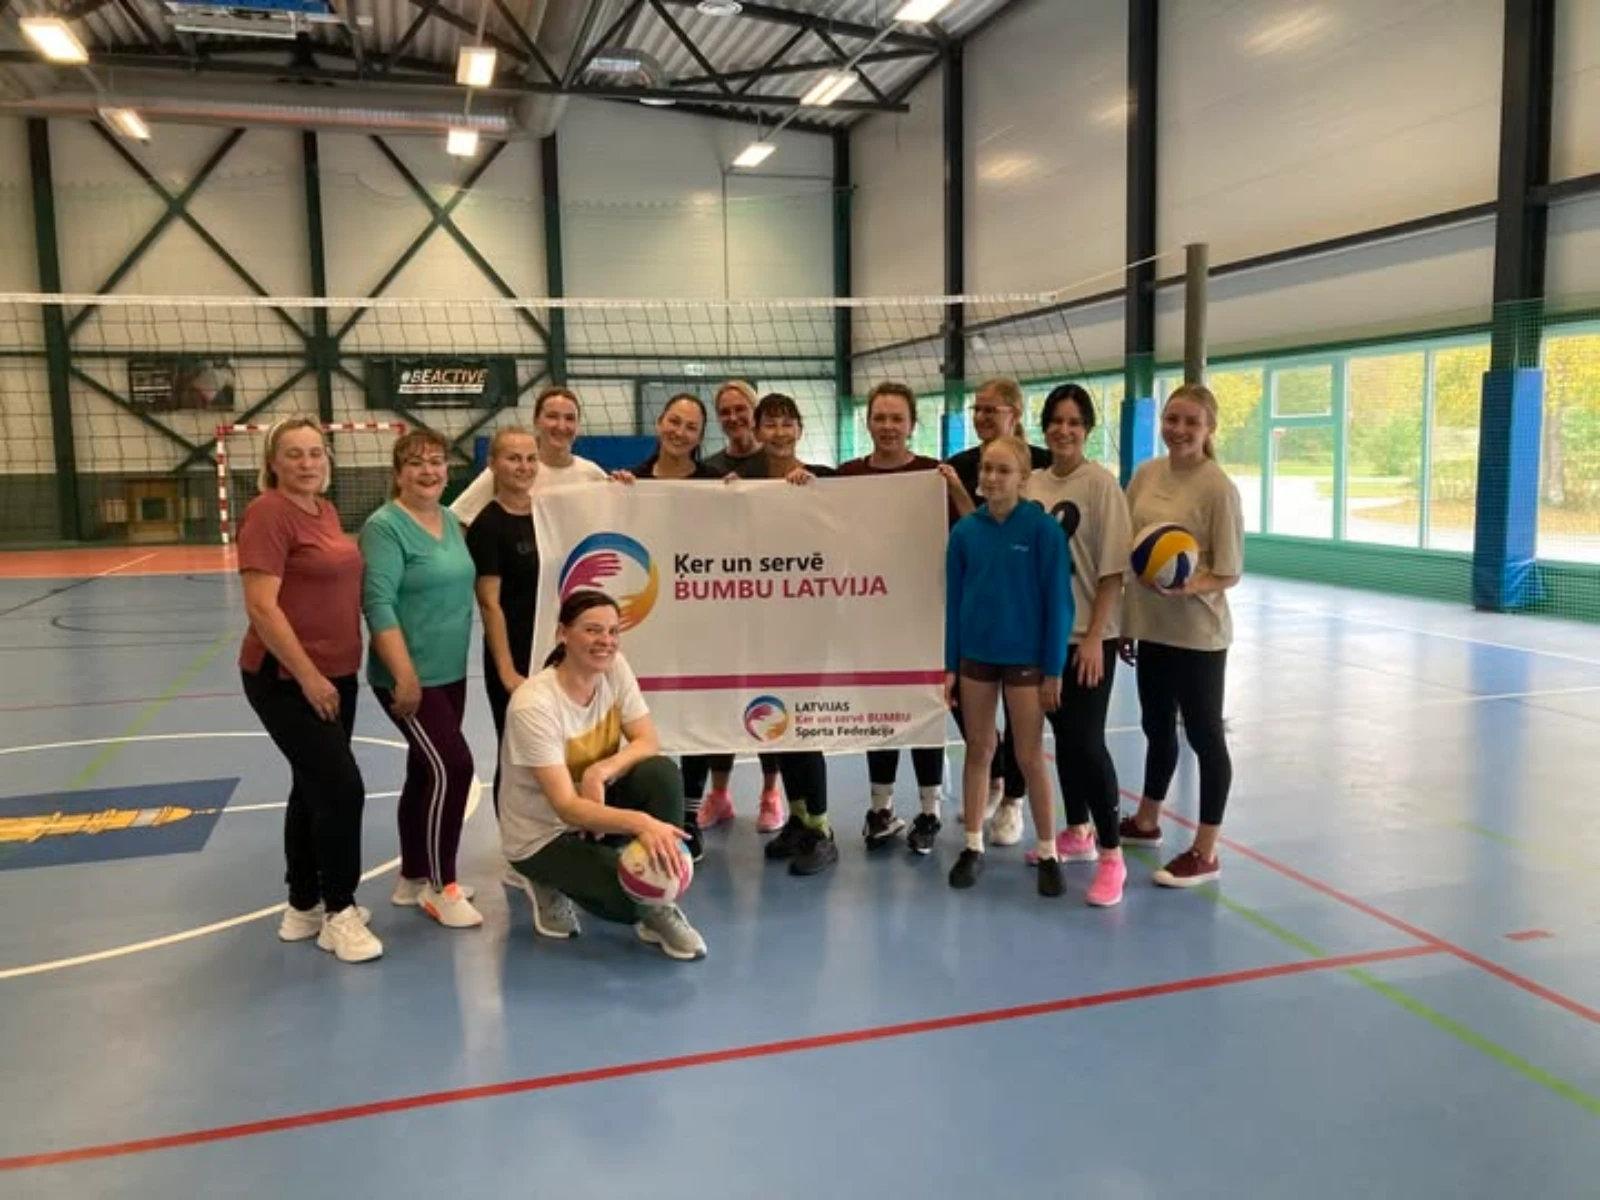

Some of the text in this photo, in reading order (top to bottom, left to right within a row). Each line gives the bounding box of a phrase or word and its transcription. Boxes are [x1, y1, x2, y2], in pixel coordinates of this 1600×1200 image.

[674, 552, 824, 578] Ķer un servē
[674, 576, 888, 600] BUMBU LATVIJA
[795, 702, 850, 712] LATVIJAS
[867, 712, 912, 722] BUMBU
[795, 726, 834, 738] Sporta
